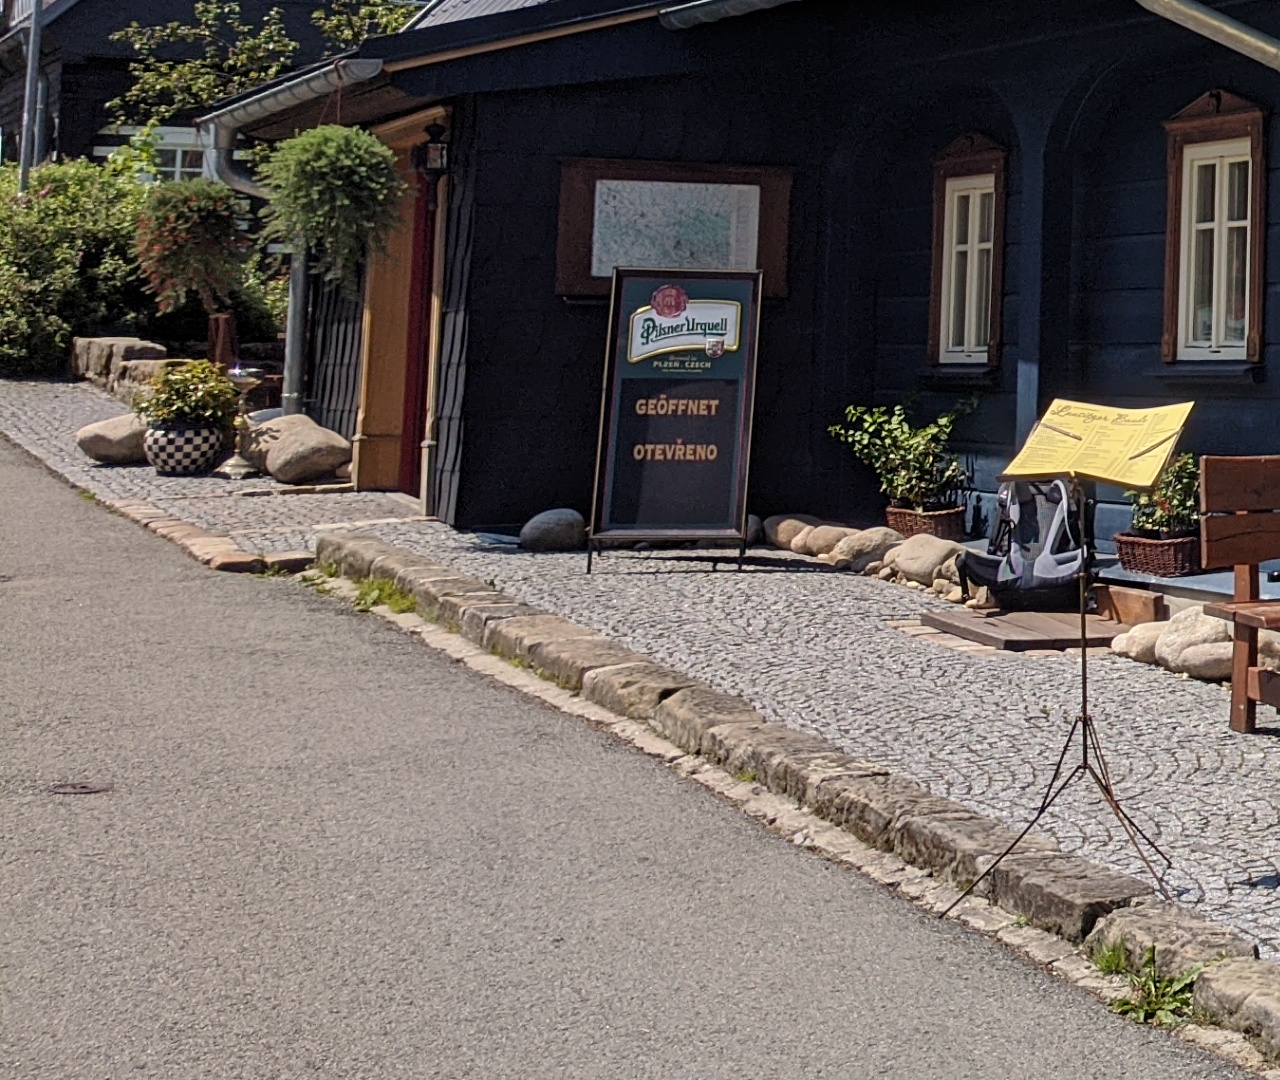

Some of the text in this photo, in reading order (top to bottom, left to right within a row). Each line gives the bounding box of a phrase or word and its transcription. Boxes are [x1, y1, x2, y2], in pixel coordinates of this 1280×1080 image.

[641, 316, 728, 345] Pilsner Urquell
[635, 394, 719, 415] GEÖFFNET
[633, 438, 718, 460] OTEVŘENO
